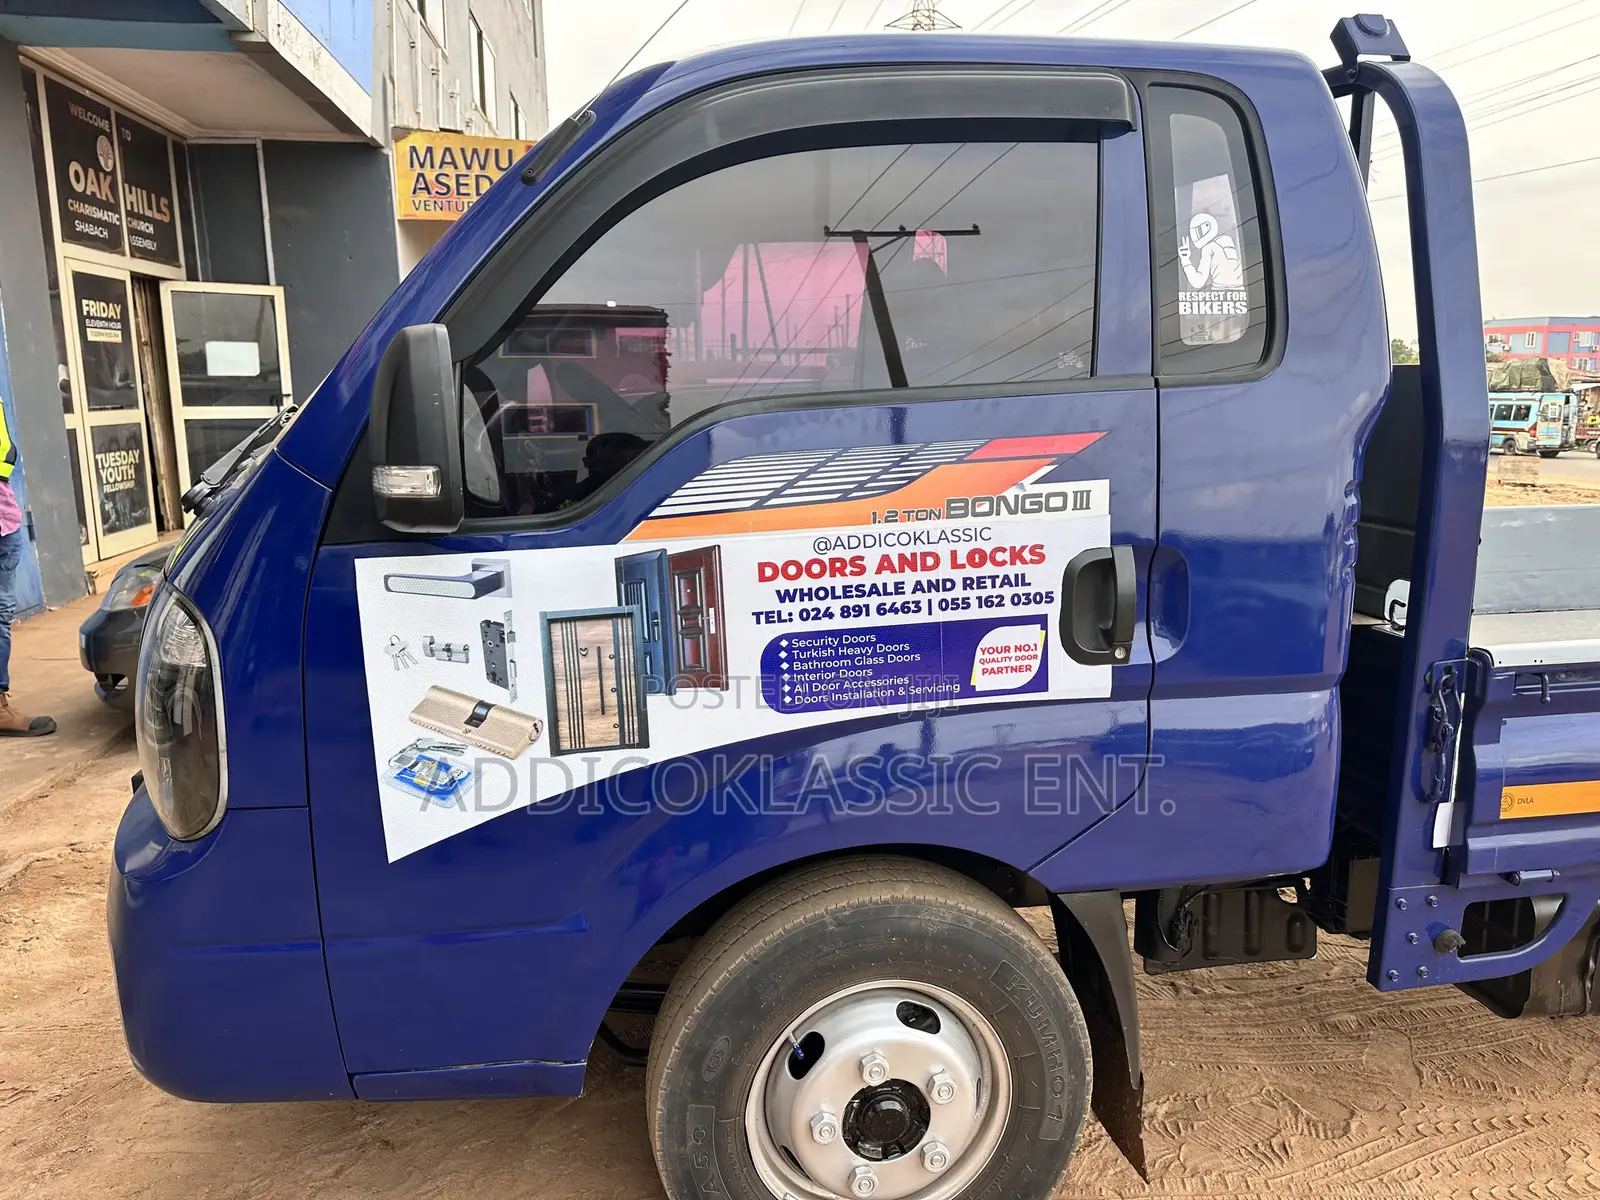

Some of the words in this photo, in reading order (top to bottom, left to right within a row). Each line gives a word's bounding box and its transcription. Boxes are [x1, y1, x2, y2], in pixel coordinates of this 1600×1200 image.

[68, 101, 111, 132] WELCOME
[121, 127, 132, 141] TO
[68, 160, 115, 204] OAK
[124, 183, 170, 223] HILLS
[67, 199, 120, 226] CHARISMATIC
[127, 216, 154, 235] CHURCH
[74, 219, 109, 239] SHABACH
[1178, 291, 1225, 302] RESPECT
[1226, 291, 1247, 302] FOR
[81, 298, 122, 319] FRIDAY
[1178, 301, 1248, 315] BIKERS
[95, 449, 140, 469] TUESDAY
[99, 464, 135, 485] YOUTH
[871, 509, 899, 524] 1.2
[902, 508, 942, 522] TON
[945, 491, 1068, 520] BONGO
[812, 526, 992, 555] @ADDICOKLASSIC
[757, 555, 867, 583] DOORS
[874, 550, 941, 576] AND
[950, 543, 1046, 570] LOCKS
[775, 581, 906, 603] WHOLESALE
[911, 578, 956, 595] AND
[962, 573, 1032, 591] RETAIL
[752, 610, 794, 625] TEL:
[798, 606, 835, 622] 024
[839, 603, 871, 619] 891
[875, 600, 922, 616] 6463
[938, 596, 972, 612] 055
[975, 594, 1006, 609] 162
[1010, 591, 1055, 606] 0305
[791, 635, 840, 648] Security
[842, 634, 877, 644] Doors
[791, 647, 835, 659] Turkish
[838, 646, 873, 655] Heavy
[876, 643, 910, 653] Doors
[979, 645, 1011, 656] YOUR
[1014, 643, 1038, 653] NO.1
[793, 659, 852, 671] Bathroom
[854, 656, 884, 666] Glass
[887, 653, 921, 664] Doors
[978, 656, 1013, 666] QUALITY
[1014, 654, 1038, 662] DOOR
[981, 664, 1032, 676] PARTNER
[793, 670, 836, 682] Interior
[839, 668, 873, 678] Doors
[793, 682, 809, 694] All
[812, 681, 840, 692] Door
[843, 675, 910, 689] Accessories
[794, 694, 829, 705] Doors
[831, 687, 895, 701] Installation
[897, 686, 906, 696] &
[908, 682, 961, 694] Servicing
[1517, 797, 1534, 805] DVLA
